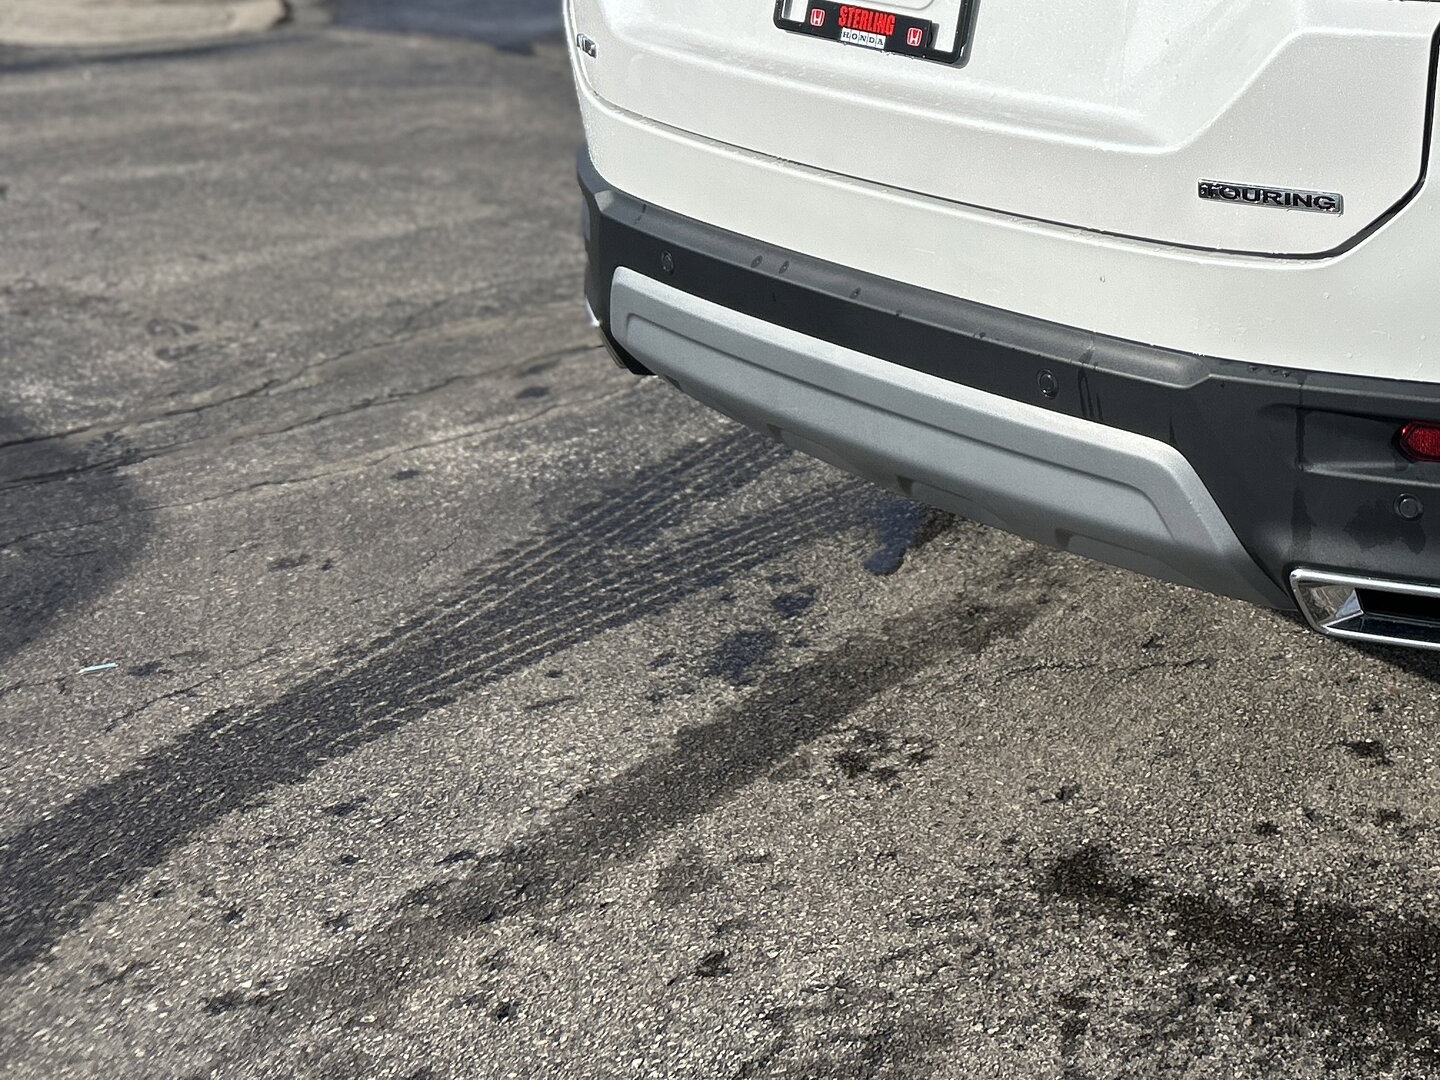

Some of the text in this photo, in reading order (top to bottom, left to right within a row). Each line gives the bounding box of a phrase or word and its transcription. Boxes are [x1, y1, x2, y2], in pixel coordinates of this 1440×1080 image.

[838, 5, 896, 36] STERLING
[841, 30, 885, 46] HONDA
[1199, 183, 1336, 210] TOURING
